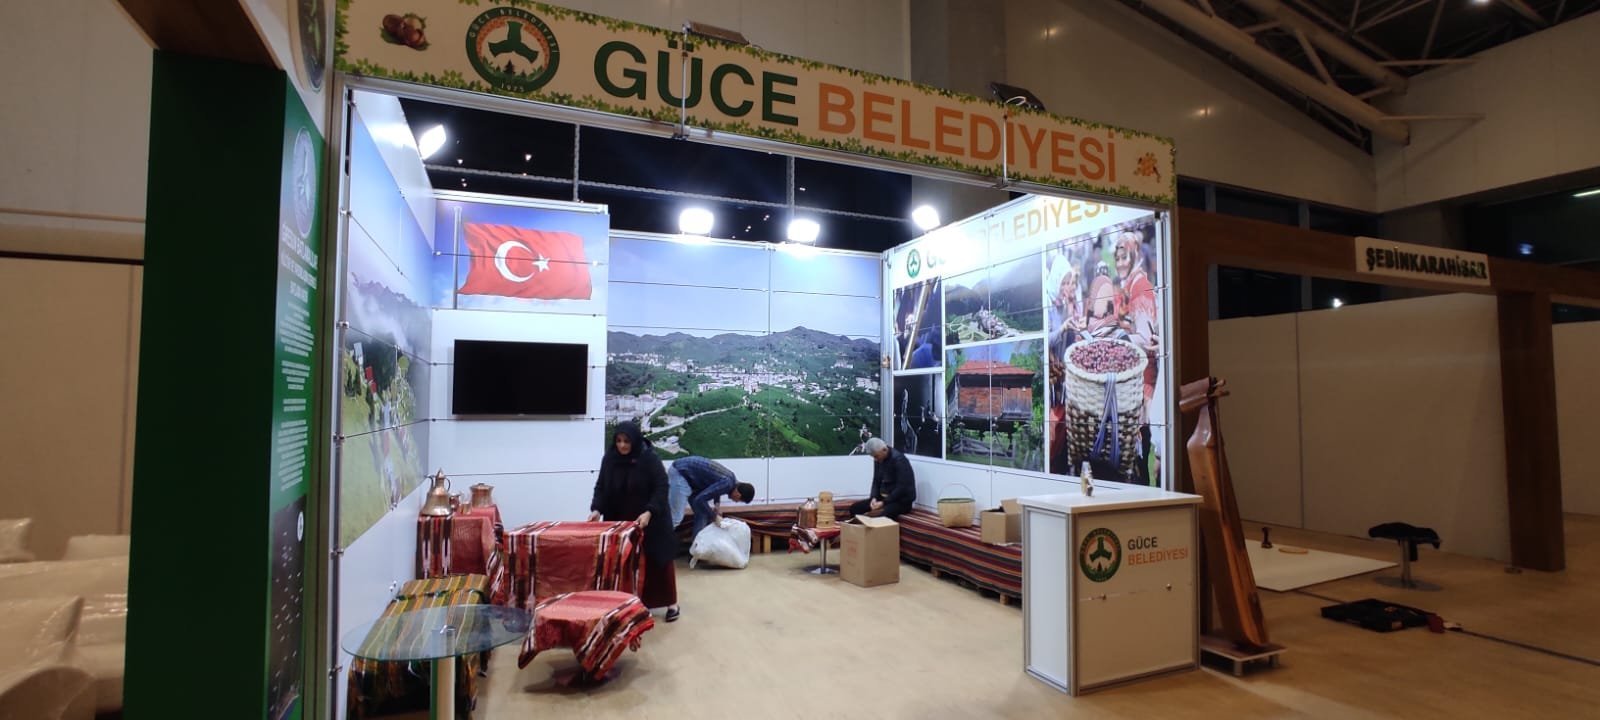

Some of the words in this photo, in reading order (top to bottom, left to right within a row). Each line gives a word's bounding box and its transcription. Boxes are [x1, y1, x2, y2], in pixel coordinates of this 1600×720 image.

[594, 40, 799, 126] GÜCE
[818, 82, 1117, 182] BELEDİYESİ
[1366, 246, 1487, 279] ŞEBİNKARAHİSAR
[1127, 535, 1158, 551] GÜCE
